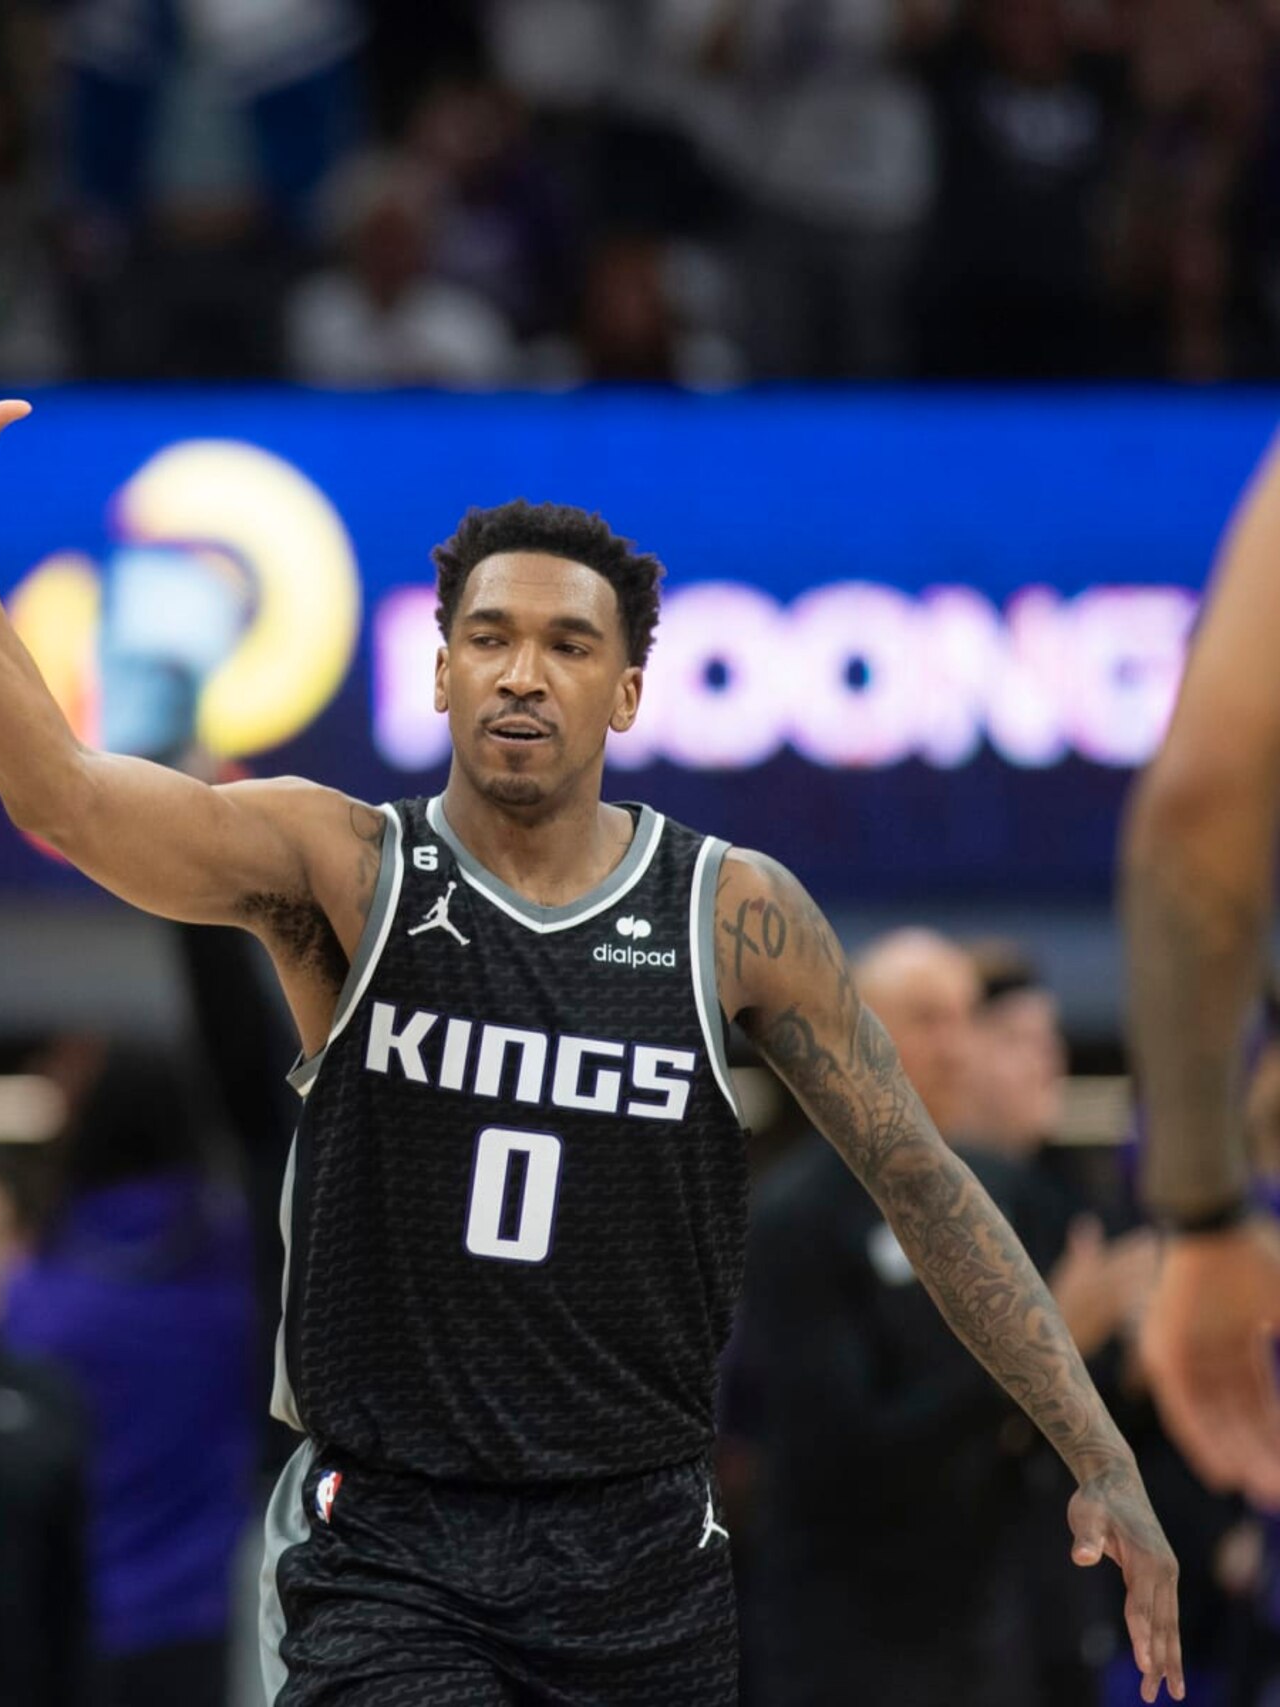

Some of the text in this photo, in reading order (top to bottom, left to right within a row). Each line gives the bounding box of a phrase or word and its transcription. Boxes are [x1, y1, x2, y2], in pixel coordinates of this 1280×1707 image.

[413, 845, 438, 871] 6
[593, 943, 676, 969] dialpad
[365, 1001, 696, 1121] KINGS
[465, 1127, 562, 1263] 0
